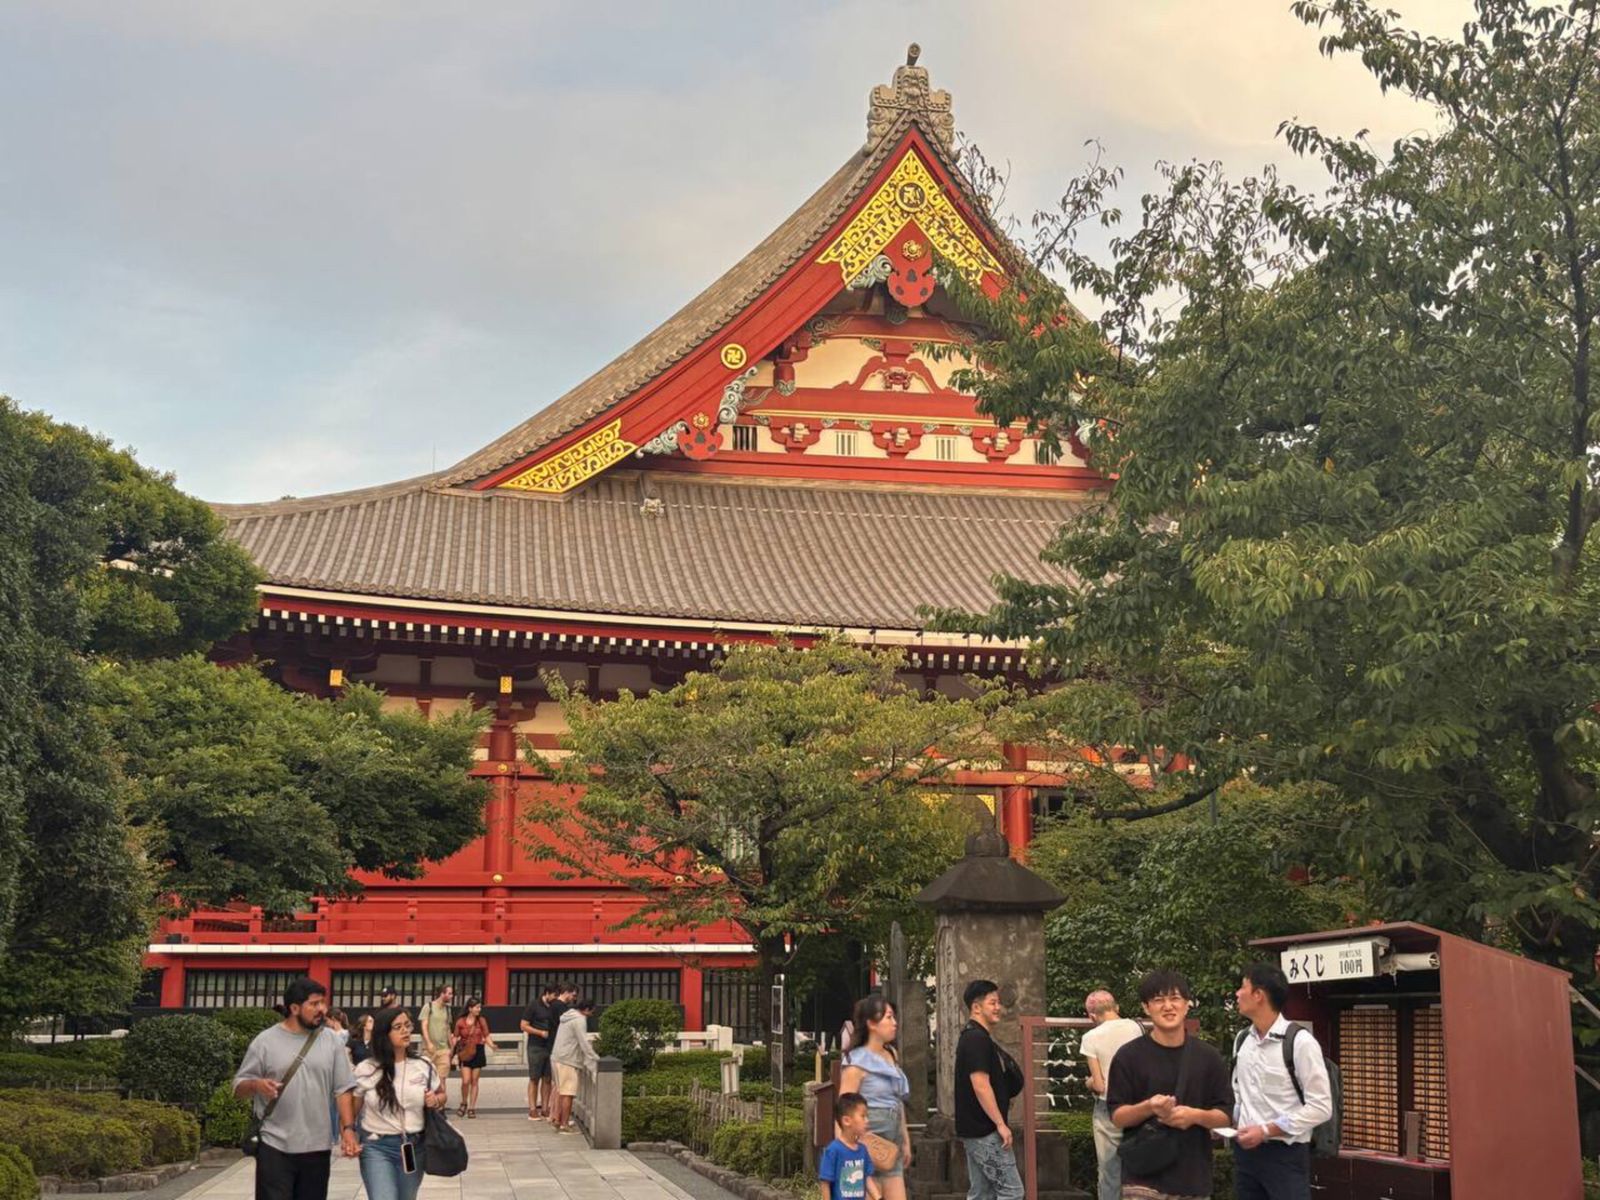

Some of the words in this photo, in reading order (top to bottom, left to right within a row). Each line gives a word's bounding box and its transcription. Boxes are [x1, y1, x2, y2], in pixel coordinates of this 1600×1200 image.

[1289, 953, 1325, 979] みくじ
[1339, 959, 1363, 974] 100円
